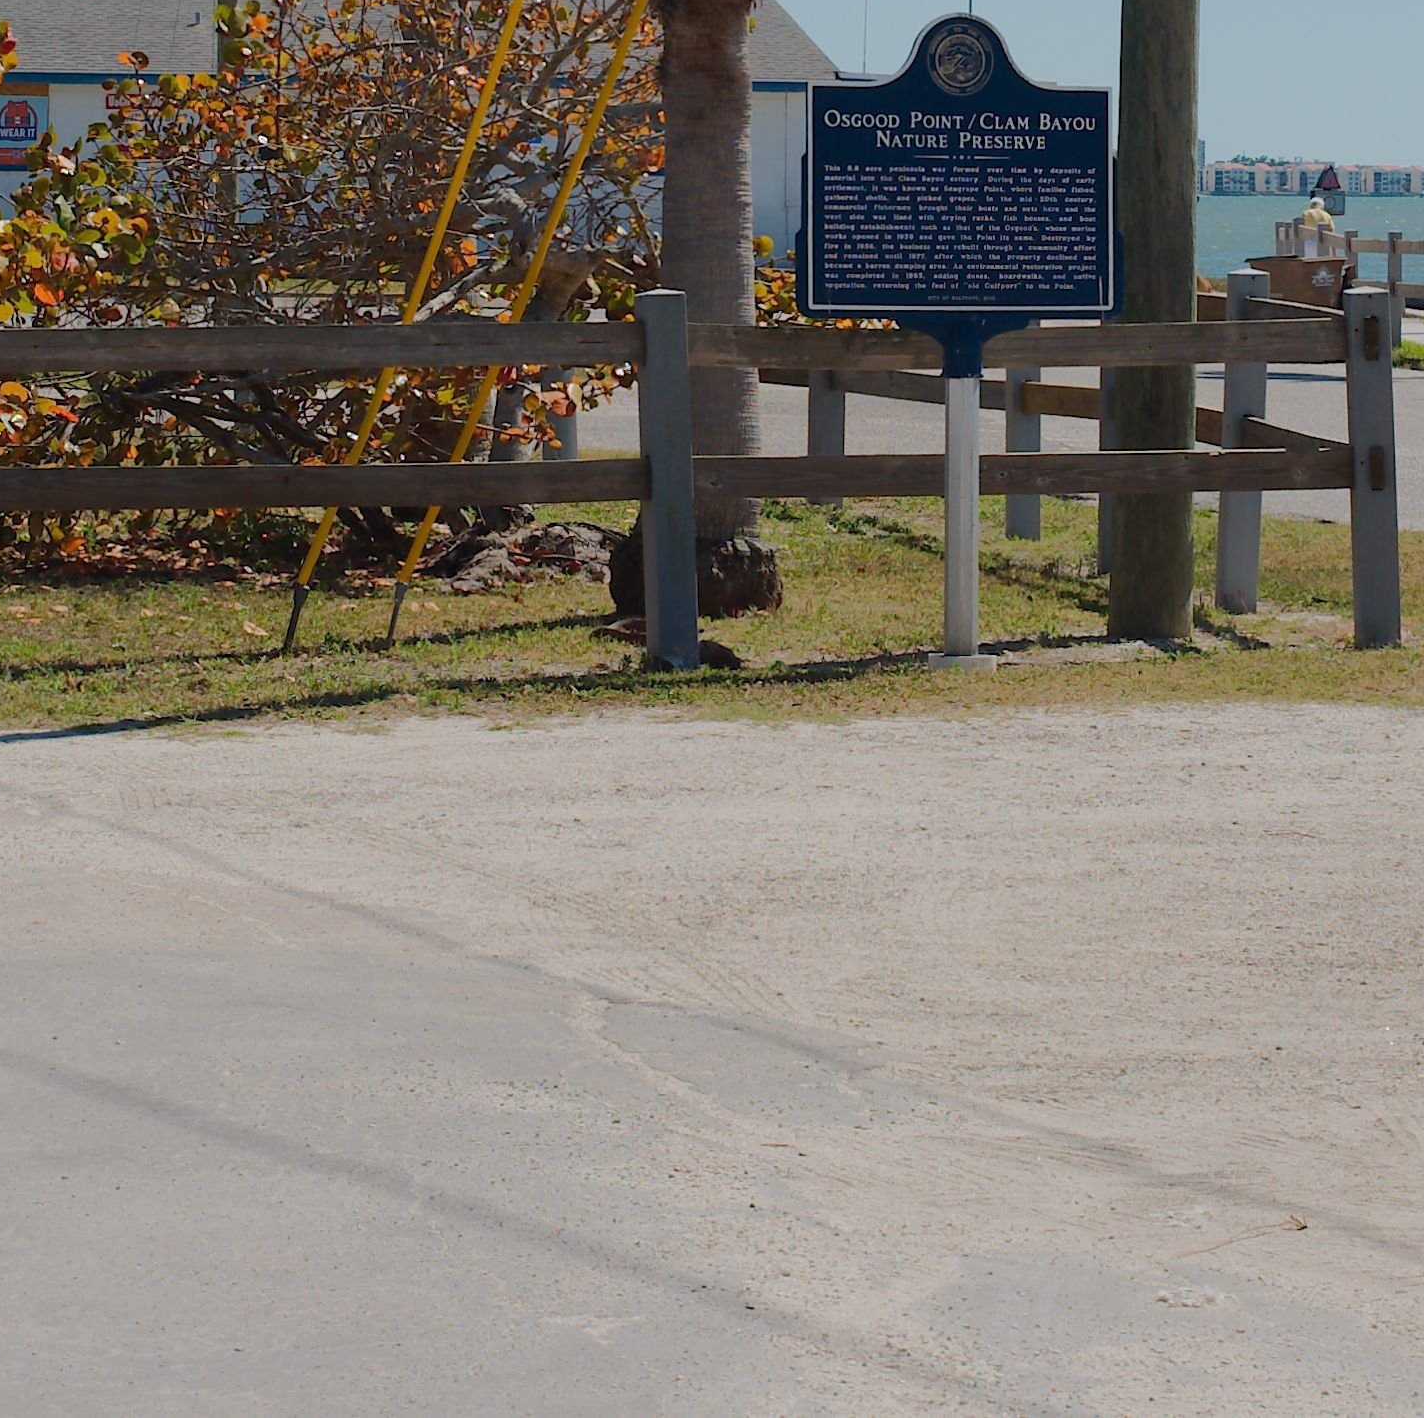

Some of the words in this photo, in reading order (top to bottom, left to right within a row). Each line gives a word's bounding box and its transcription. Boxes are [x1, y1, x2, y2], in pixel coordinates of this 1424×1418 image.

[0, 127, 26, 138] WEAR
[27, 127, 36, 138] IT
[823, 164, 841, 172] This
[888, 165, 926, 173] peninsula
[952, 165, 980, 173] formed
[1033, 167, 1044, 175] by
[1049, 167, 1082, 175] deposits
[1086, 167, 1096, 175] of
[823, 174, 857, 182] material
[860, 174, 876, 182] into
[897, 174, 917, 182] Clam
[921, 175, 945, 183] Bayou
[987, 175, 1014, 185] During
[1020, 176, 1033, 184] the
[1038, 177, 1056, 185] days
[1061, 176, 1071, 184] of
[1075, 177, 1096, 185] early
[871, 184, 879, 192] it
[901, 184, 927, 192] known
[1010, 185, 1033, 193] where
[1037, 185, 1067, 193] families
[823, 194, 859, 202] gathered
[916, 194, 943, 203] picked
[999, 195, 1013, 203] the
[823, 203, 868, 211] commercial
[873, 203, 912, 211] fishermen
[918, 204, 949, 213] brought
[954, 204, 974, 212] their
[849, 213, 865, 221] side
[893, 213, 913, 221] lined
[940, 214, 967, 223] drying
[1003, 214, 1018, 222] fish
[1079, 215, 1096, 223] boat
[823, 223, 856, 232] building
[859, 223, 916, 231] establishments
[975, 224, 985, 232] of
[988, 224, 1001, 232] the
[1070, 225, 1097, 233] marine
[851, 233, 880, 241] opened
[937, 234, 956, 242] gave
[976, 233, 996, 242] Point
[999, 234, 1010, 242] its
[1040, 234, 1081, 243] Destroyed
[1085, 235, 1097, 243] by
[823, 242, 840, 250] fire
[899, 243, 931, 251] business
[953, 243, 980, 251] rebuilt
[983, 243, 1014, 252] through
[1027, 244, 1069, 253] community
[1073, 244, 1097, 252] effort
[824, 252, 838, 260] and
[843, 252, 879, 260] remained
[884, 252, 903, 260] until
[933, 252, 954, 260] after
[988, 253, 1001, 261] the
[1006, 254, 1041, 262] property
[1046, 253, 1078, 261] declined
[865, 262, 891, 270] barren
[894, 262, 926, 271] dumping
[1022, 263, 1064, 271] restoration
[1067, 264, 1097, 272] project
[845, 272, 885, 280] completed
[933, 272, 959, 281] adding
[872, 282, 910, 291] returning
[931, 281, 947, 290] feel
[950, 282, 959, 290] of
